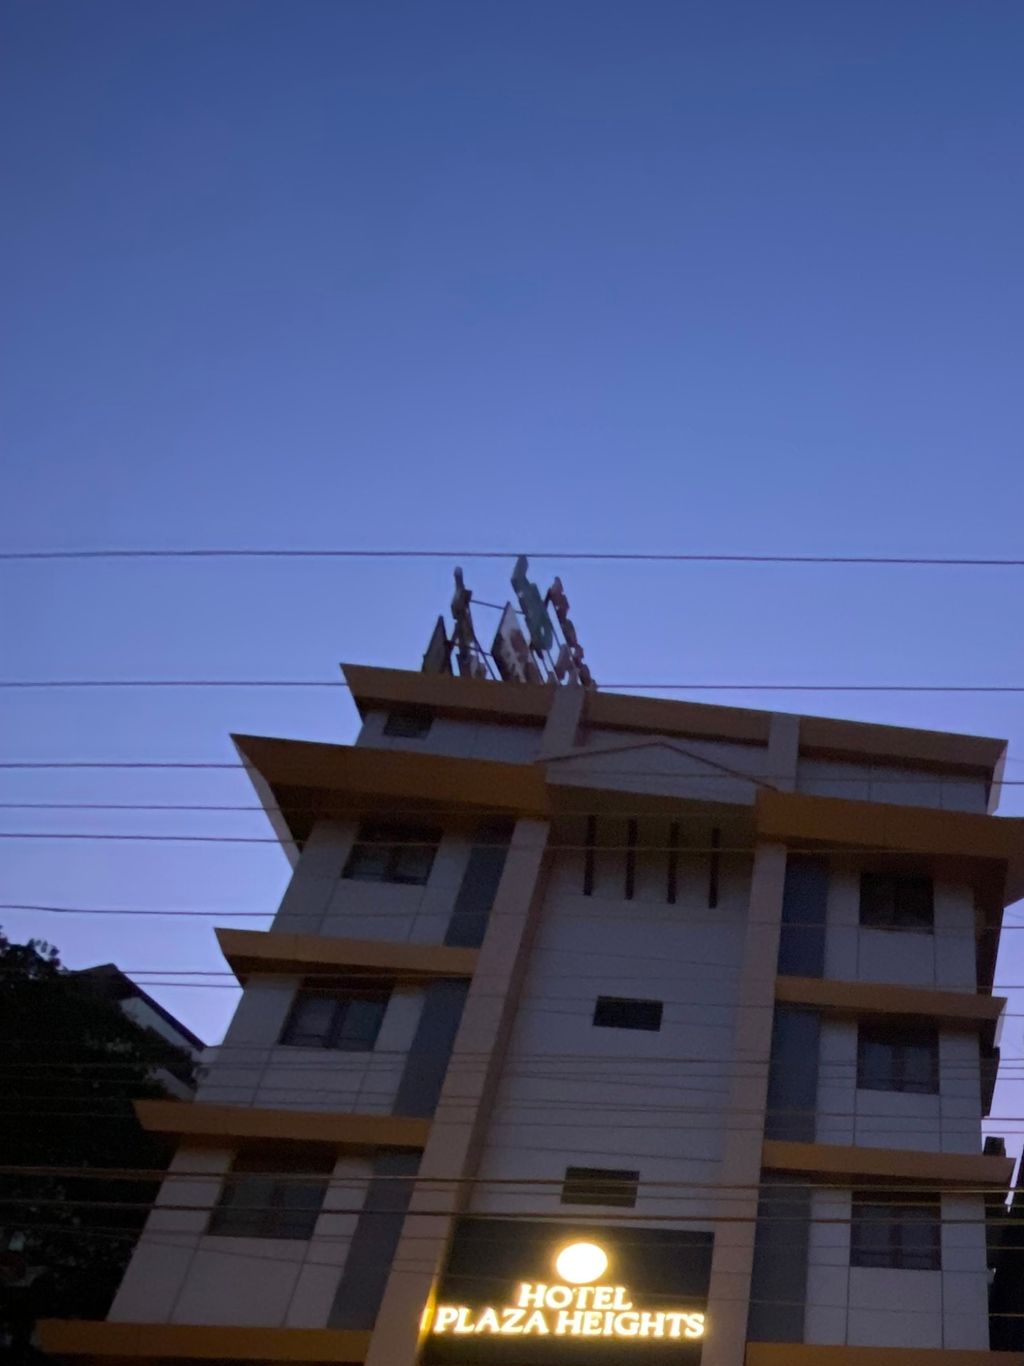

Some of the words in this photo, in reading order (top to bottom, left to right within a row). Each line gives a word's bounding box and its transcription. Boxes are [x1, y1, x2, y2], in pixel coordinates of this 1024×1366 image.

[517, 1283, 633, 1312] HOTEL
[433, 1307, 549, 1335] PLAZA
[555, 1309, 706, 1339] HEIGHTS
